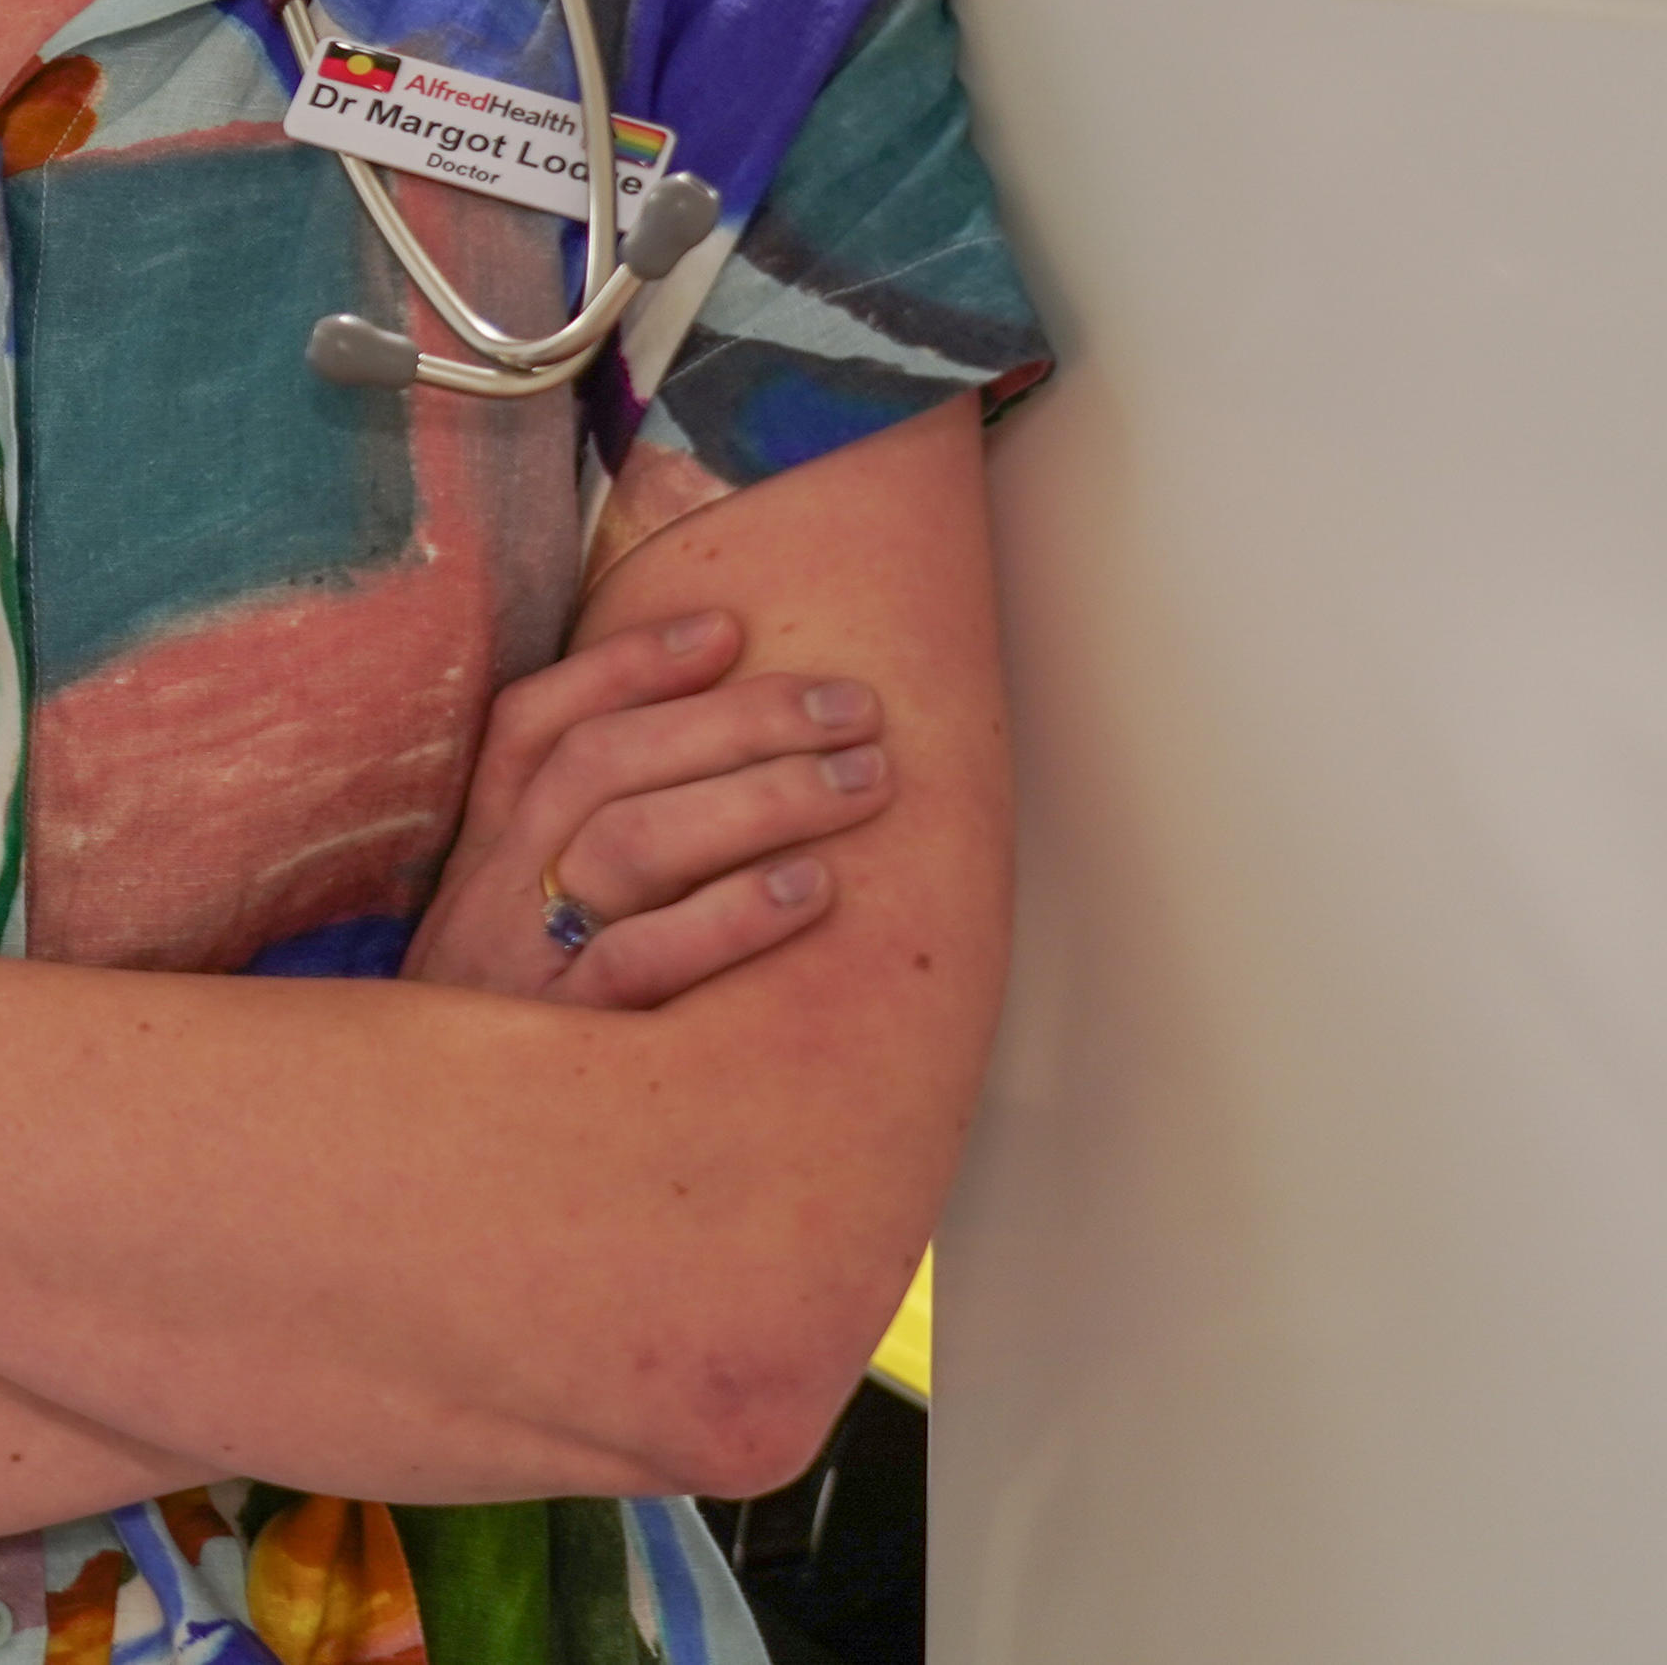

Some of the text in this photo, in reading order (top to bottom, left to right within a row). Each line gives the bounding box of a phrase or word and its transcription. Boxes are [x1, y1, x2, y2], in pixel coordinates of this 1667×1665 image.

[404, 74, 576, 136] AlfredHealth
[308, 82, 643, 195] Dr Margot Lode
[426, 152, 501, 185] Doctor
